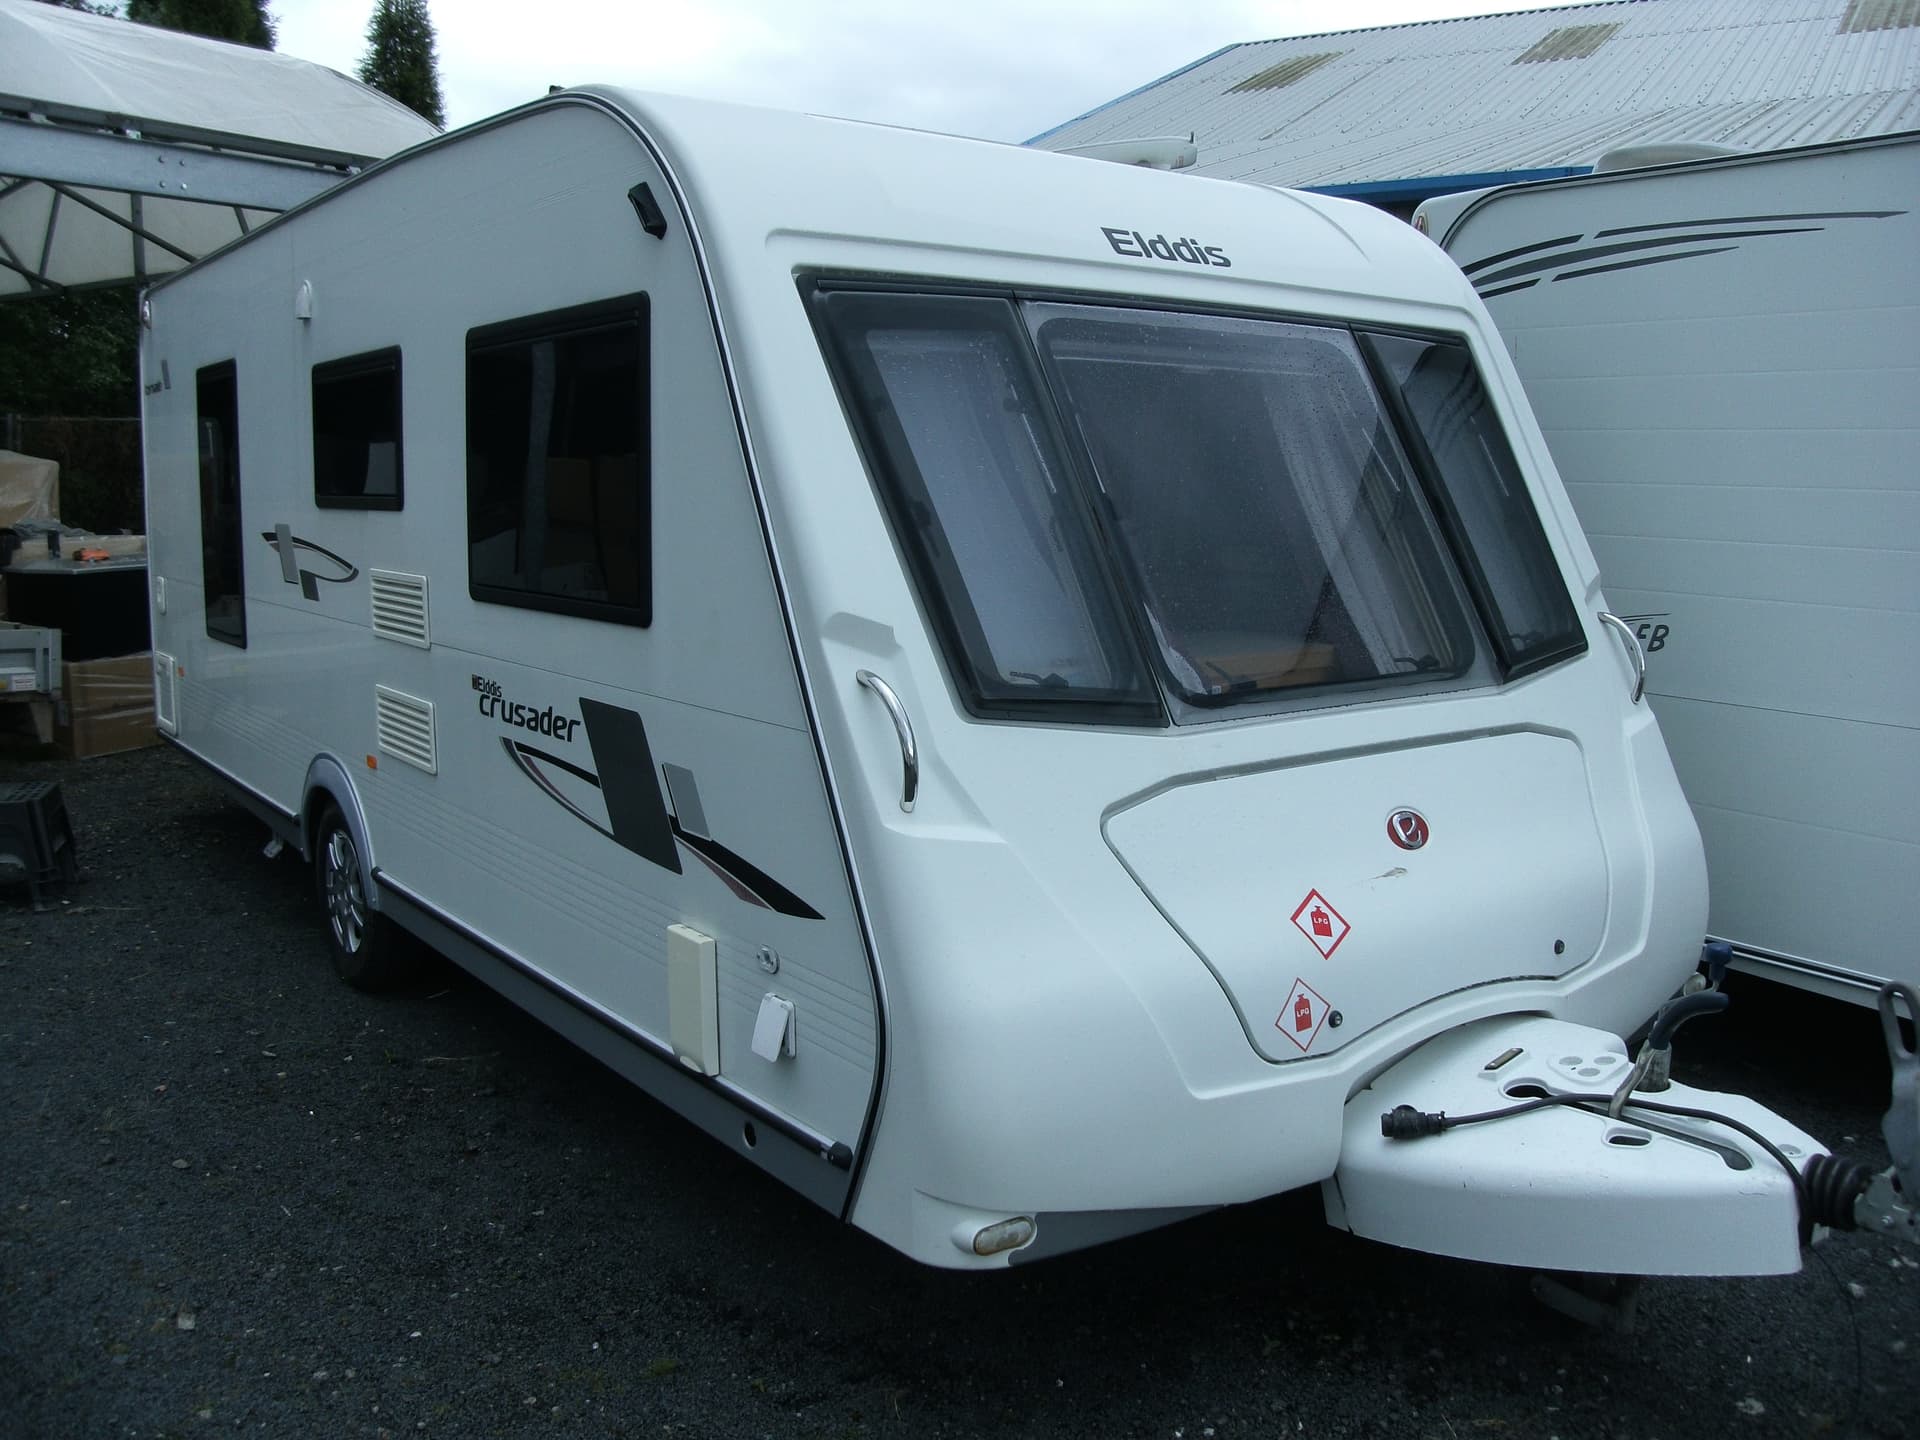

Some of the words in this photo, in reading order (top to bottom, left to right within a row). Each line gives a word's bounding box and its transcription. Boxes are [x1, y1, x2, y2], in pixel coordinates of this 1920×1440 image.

[1100, 227, 1231, 267] Elddis
[477, 676, 502, 698] Elddis
[480, 694, 581, 742] crusader
[1313, 917, 1329, 925] LPG
[1296, 1007, 1309, 1017] LPG
